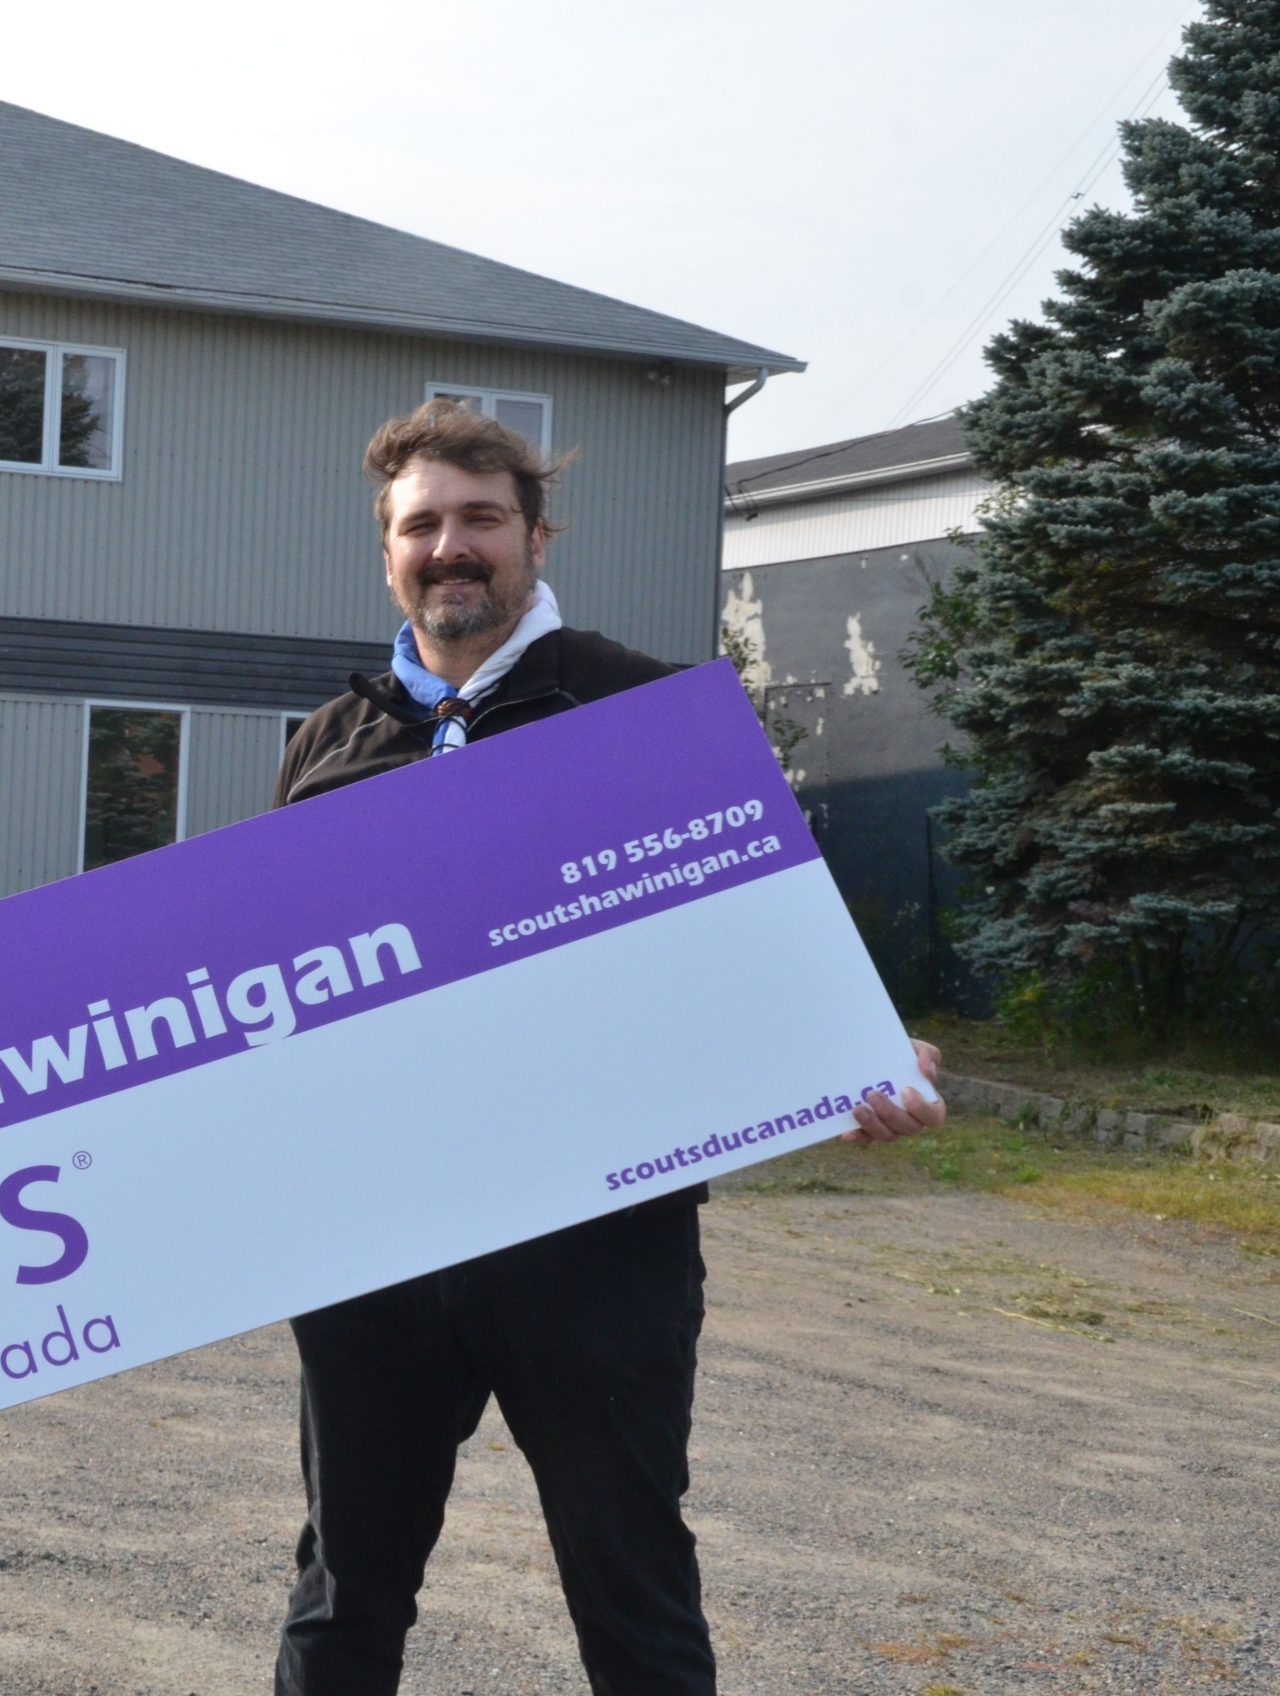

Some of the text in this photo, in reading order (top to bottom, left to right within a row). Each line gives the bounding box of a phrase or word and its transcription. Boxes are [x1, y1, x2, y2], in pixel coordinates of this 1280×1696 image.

[488, 834, 783, 947] scoutshawinigan.ca
[560, 799, 764, 884] 819 556-8709
